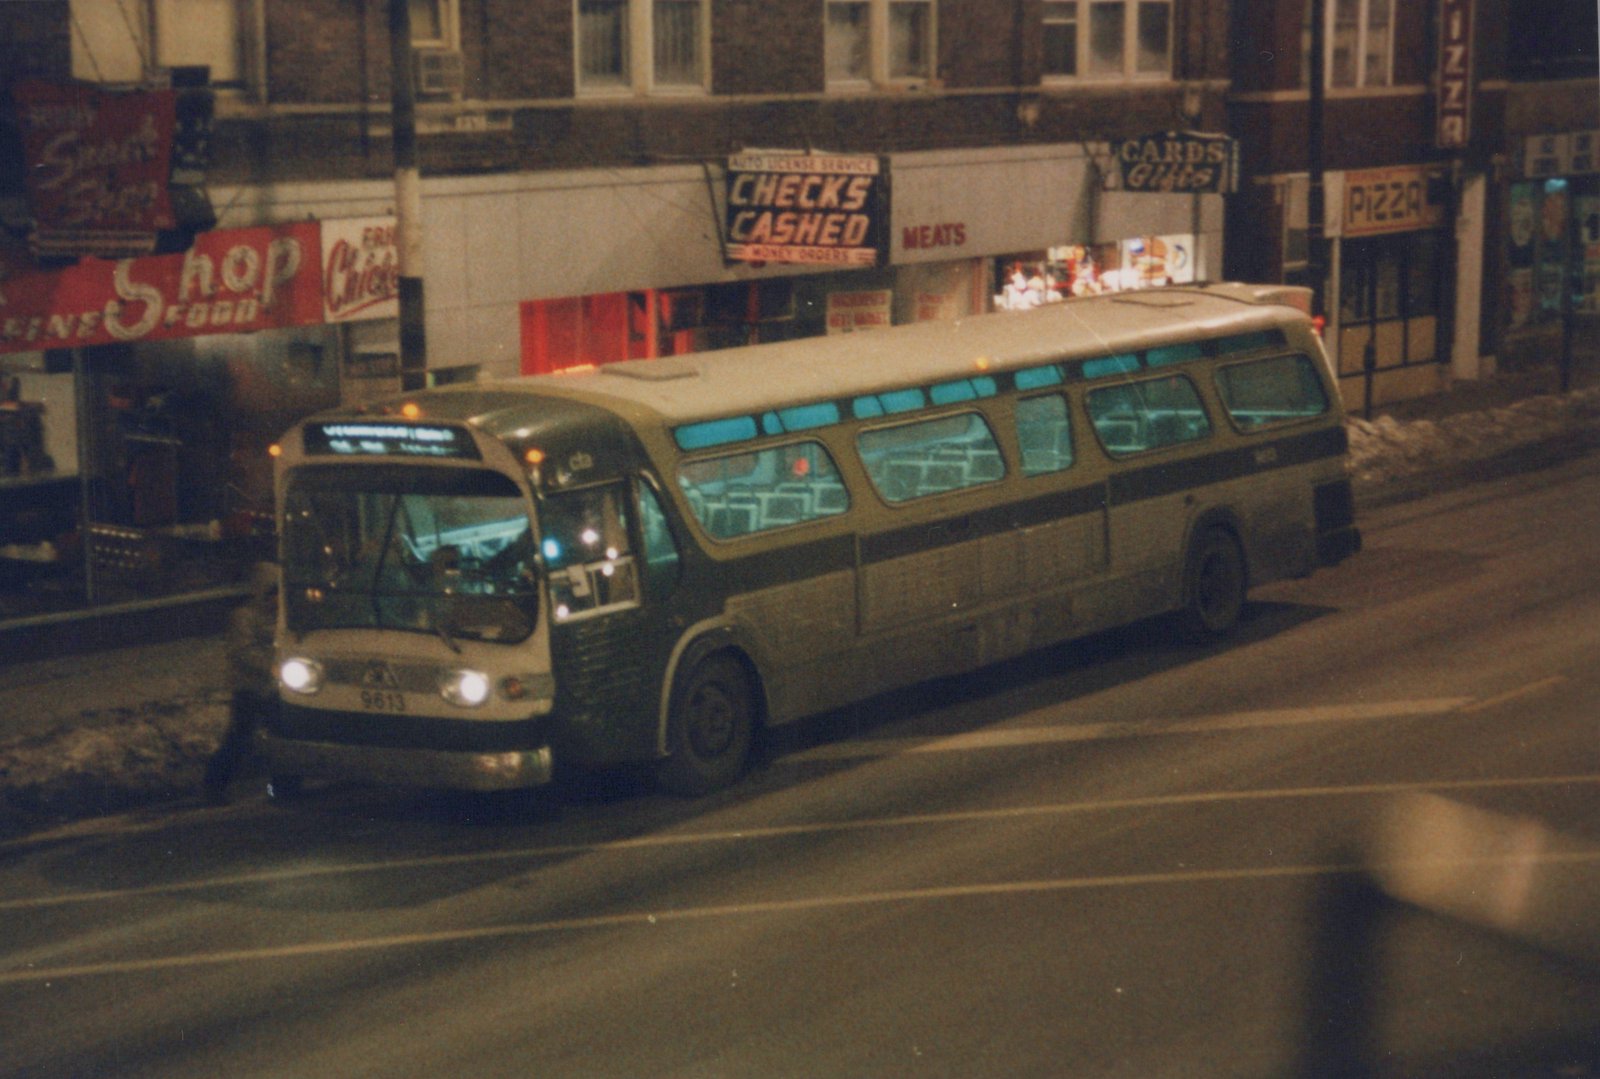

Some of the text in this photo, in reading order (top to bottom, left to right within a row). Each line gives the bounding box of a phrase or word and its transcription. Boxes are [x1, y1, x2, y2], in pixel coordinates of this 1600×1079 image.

[1444, 0, 1466, 145] IZZA
[821, 159, 873, 173] SERVICE
[1121, 139, 1225, 163] CARDS
[731, 173, 872, 210] CHECKS
[731, 210, 870, 245] CASHED
[903, 223, 966, 249] MEATS
[103, 237, 302, 341] Shop
